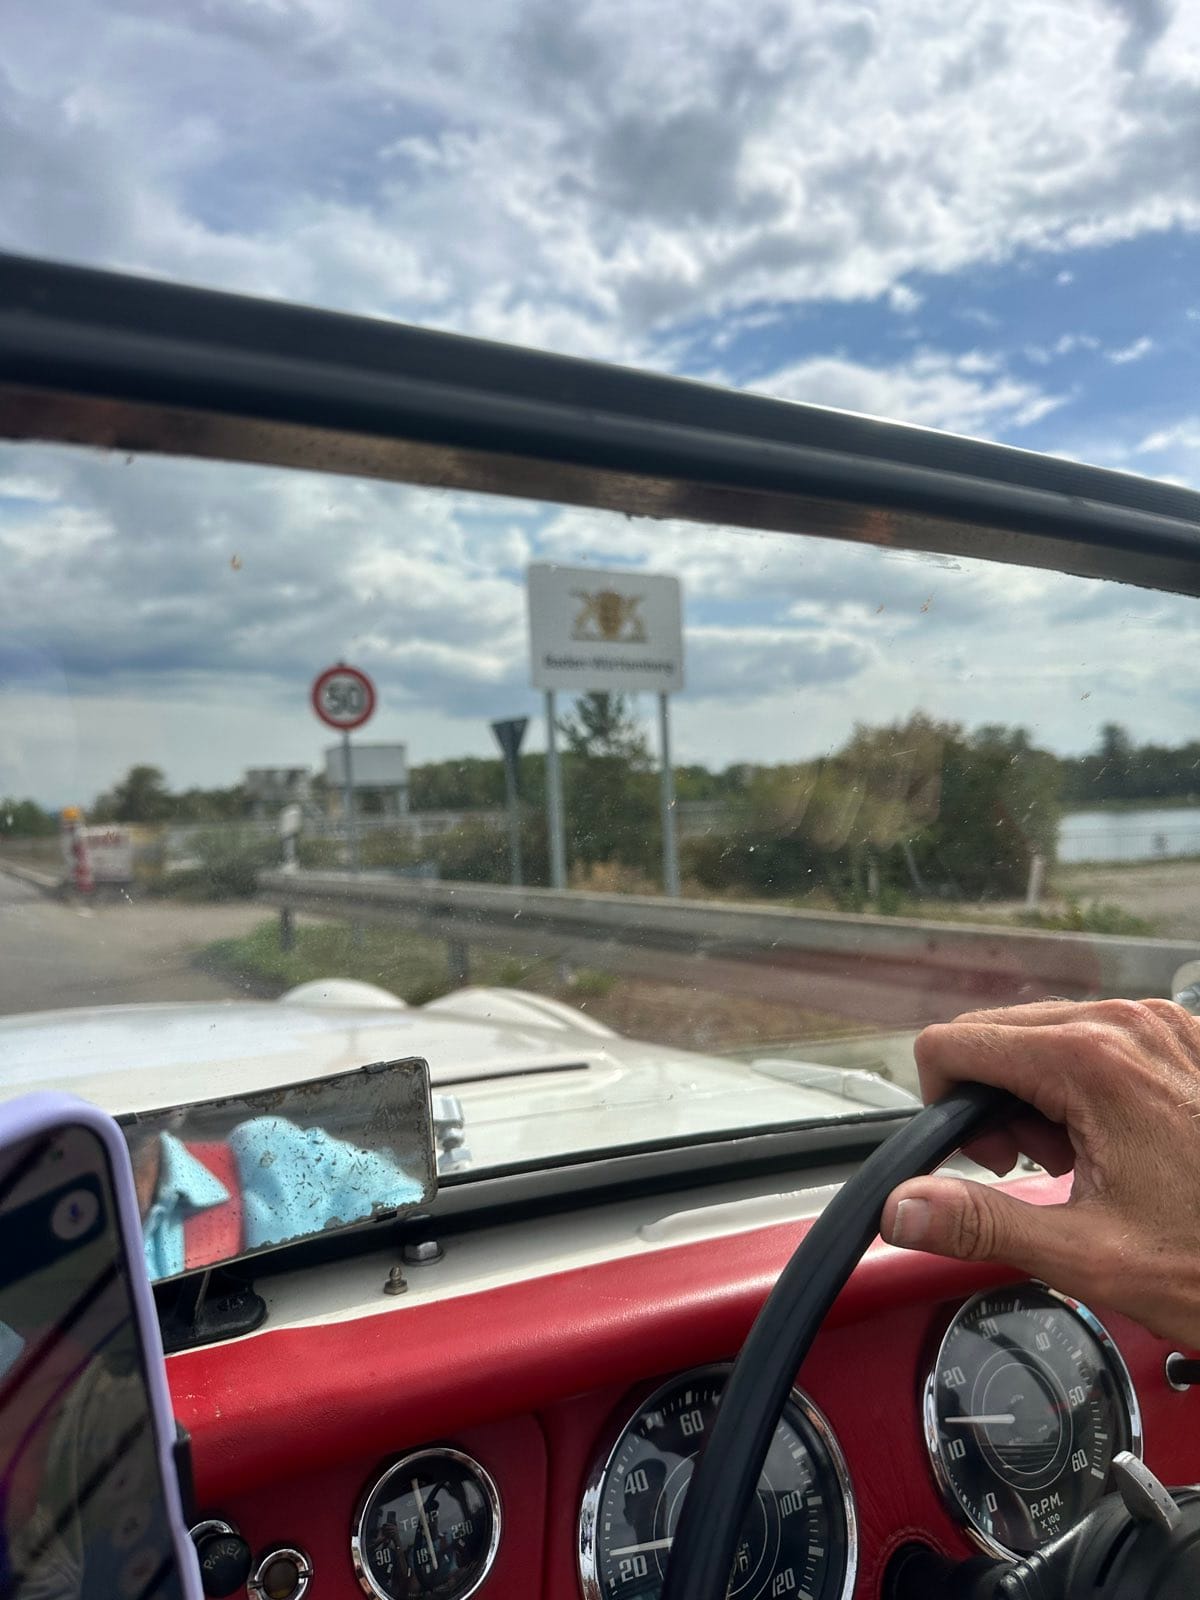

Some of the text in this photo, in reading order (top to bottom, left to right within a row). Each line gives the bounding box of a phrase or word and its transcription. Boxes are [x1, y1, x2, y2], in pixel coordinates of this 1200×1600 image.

[327, 684, 365, 715] 50
[979, 1318, 1000, 1341] 30
[1035, 1332, 1050, 1351] 40
[943, 1366, 965, 1388] 20
[1068, 1386, 1085, 1407] 50
[679, 1409, 705, 1437] 60
[948, 1438, 966, 1461] 10
[1071, 1448, 1088, 1472] 60
[624, 1468, 649, 1495] 40
[779, 1490, 805, 1520] 100
[986, 1493, 999, 1513] 0
[1030, 1491, 1064, 1519] R.P.M.
[451, 1519, 473, 1540] 230
[1047, 1513, 1061, 1525] 100
[375, 1548, 391, 1566] 90
[619, 1555, 648, 1583] 20
[772, 1567, 796, 1598] 120
